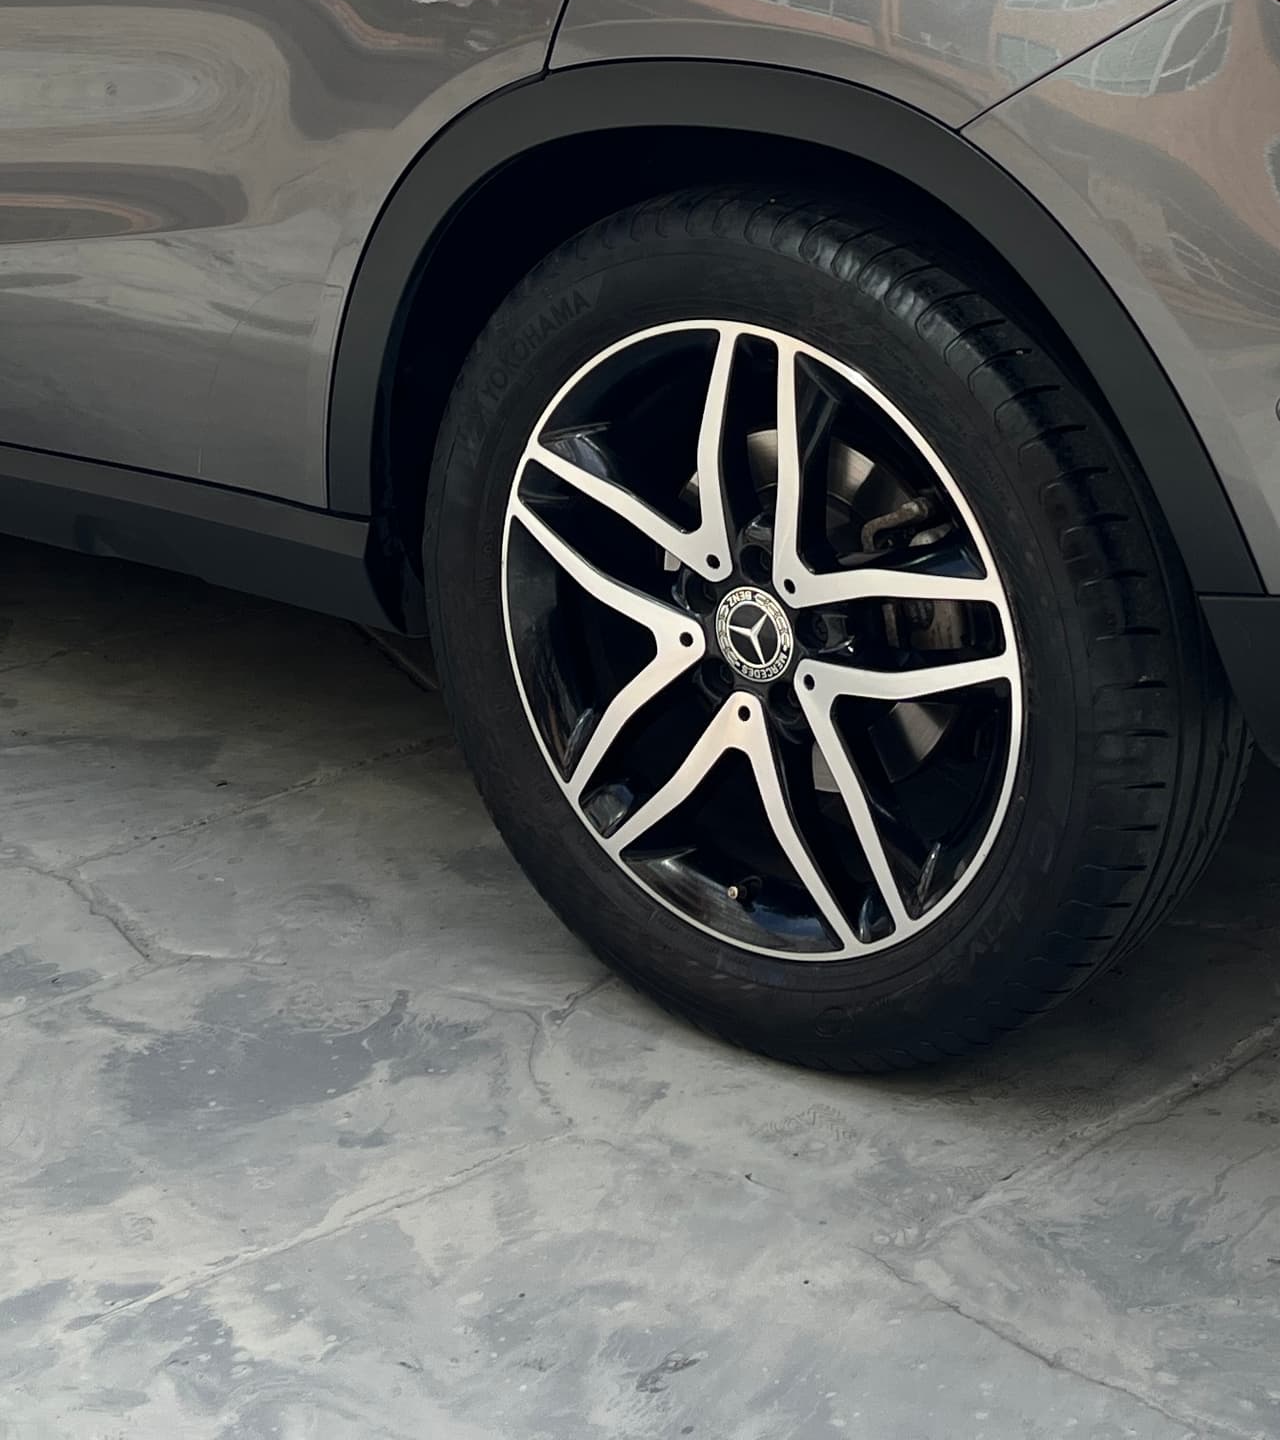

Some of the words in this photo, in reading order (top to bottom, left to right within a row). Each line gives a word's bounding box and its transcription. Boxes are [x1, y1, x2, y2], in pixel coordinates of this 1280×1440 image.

[479, 287, 593, 402] YOKOHAMA
[727, 590, 752, 608] BENZ
[740, 651, 788, 679] MERCEDES
